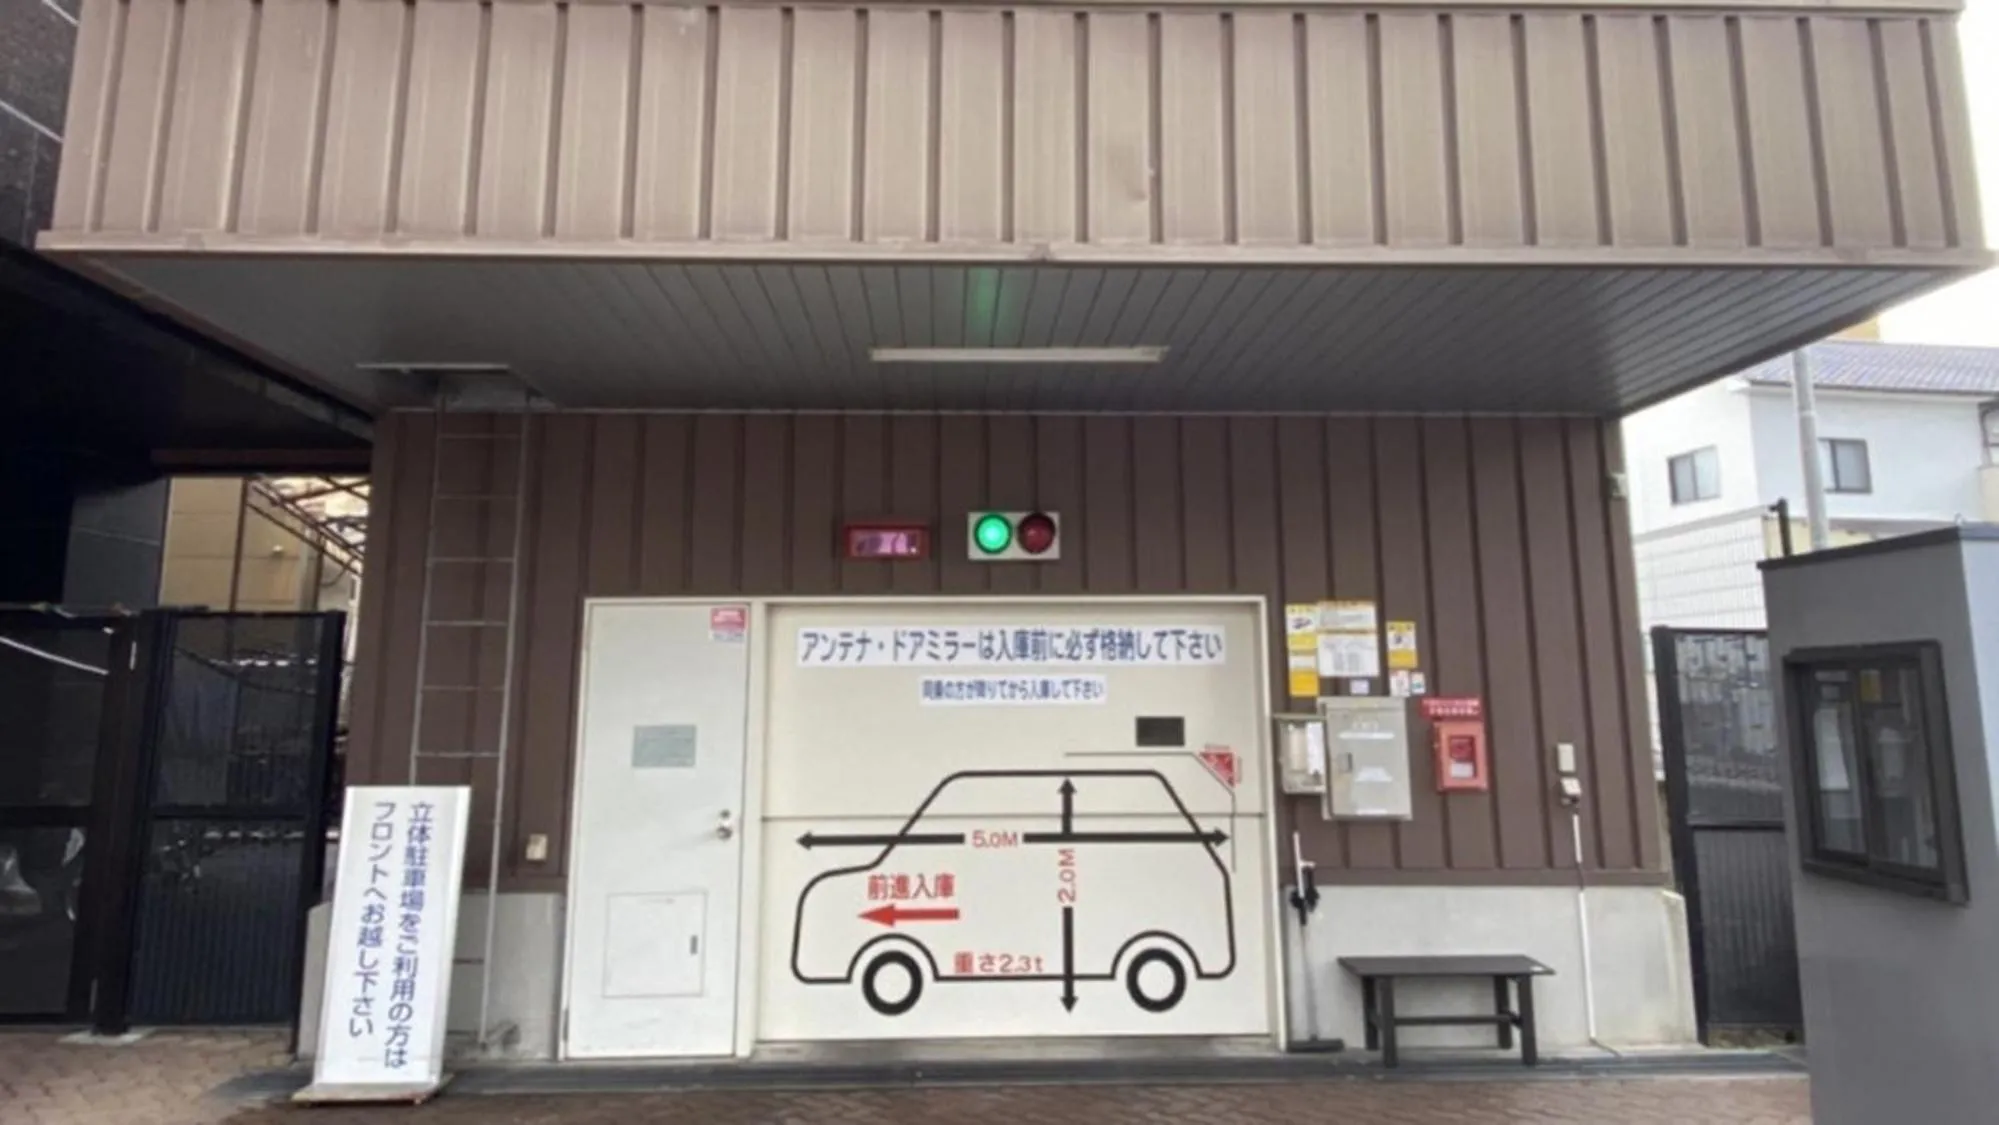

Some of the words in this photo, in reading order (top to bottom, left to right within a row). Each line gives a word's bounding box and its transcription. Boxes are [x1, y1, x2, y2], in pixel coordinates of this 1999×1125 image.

[801, 628, 1223, 662] アンテナ・ドアミラーは入庫前に必ず格納して下さい
[971, 831, 1019, 848] 5.0M
[867, 873, 955, 899] 前進入庫
[1057, 848, 1077, 903] 2.0M
[349, 802, 396, 1038] フロントへお越し下さい
[384, 802, 433, 1068] 立体駐車場をご利用の方は
